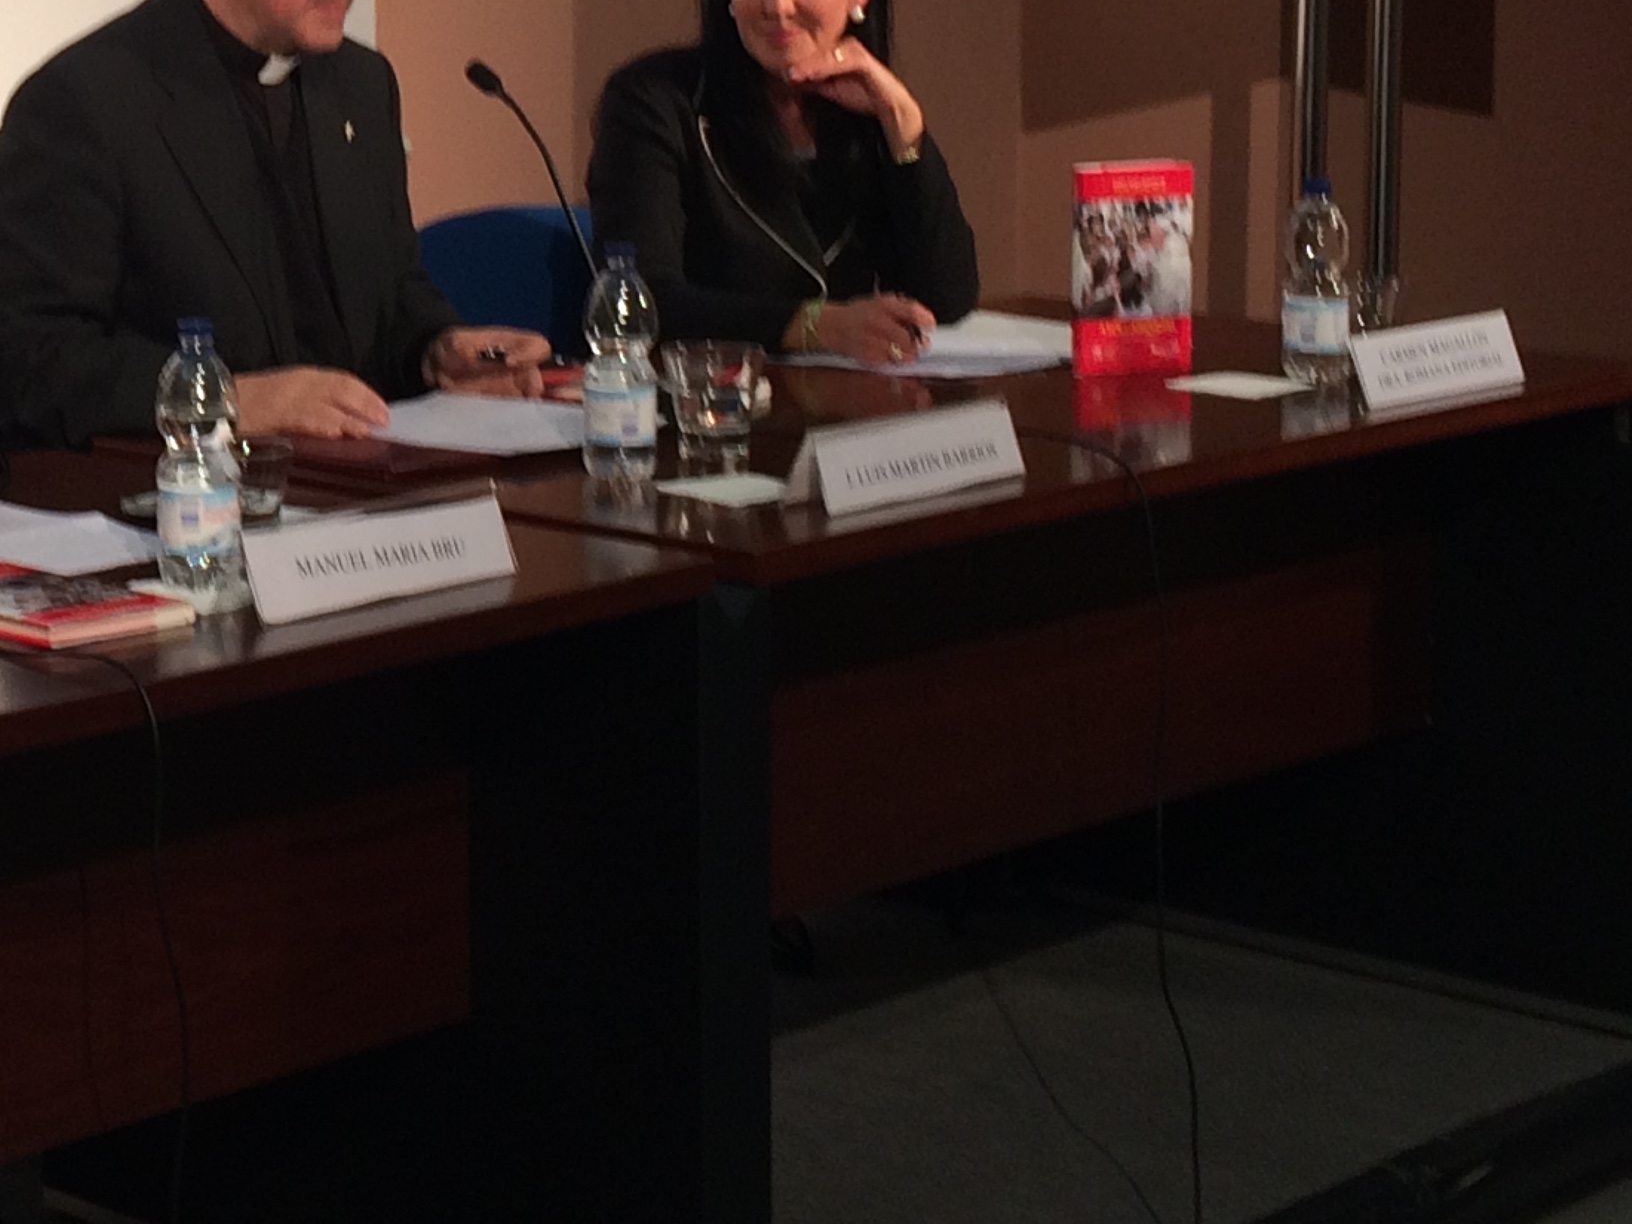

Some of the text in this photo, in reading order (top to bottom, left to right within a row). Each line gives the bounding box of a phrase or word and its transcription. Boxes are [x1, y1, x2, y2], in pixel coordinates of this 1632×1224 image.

[294, 533, 468, 580] MANUEL MARIA BRU
